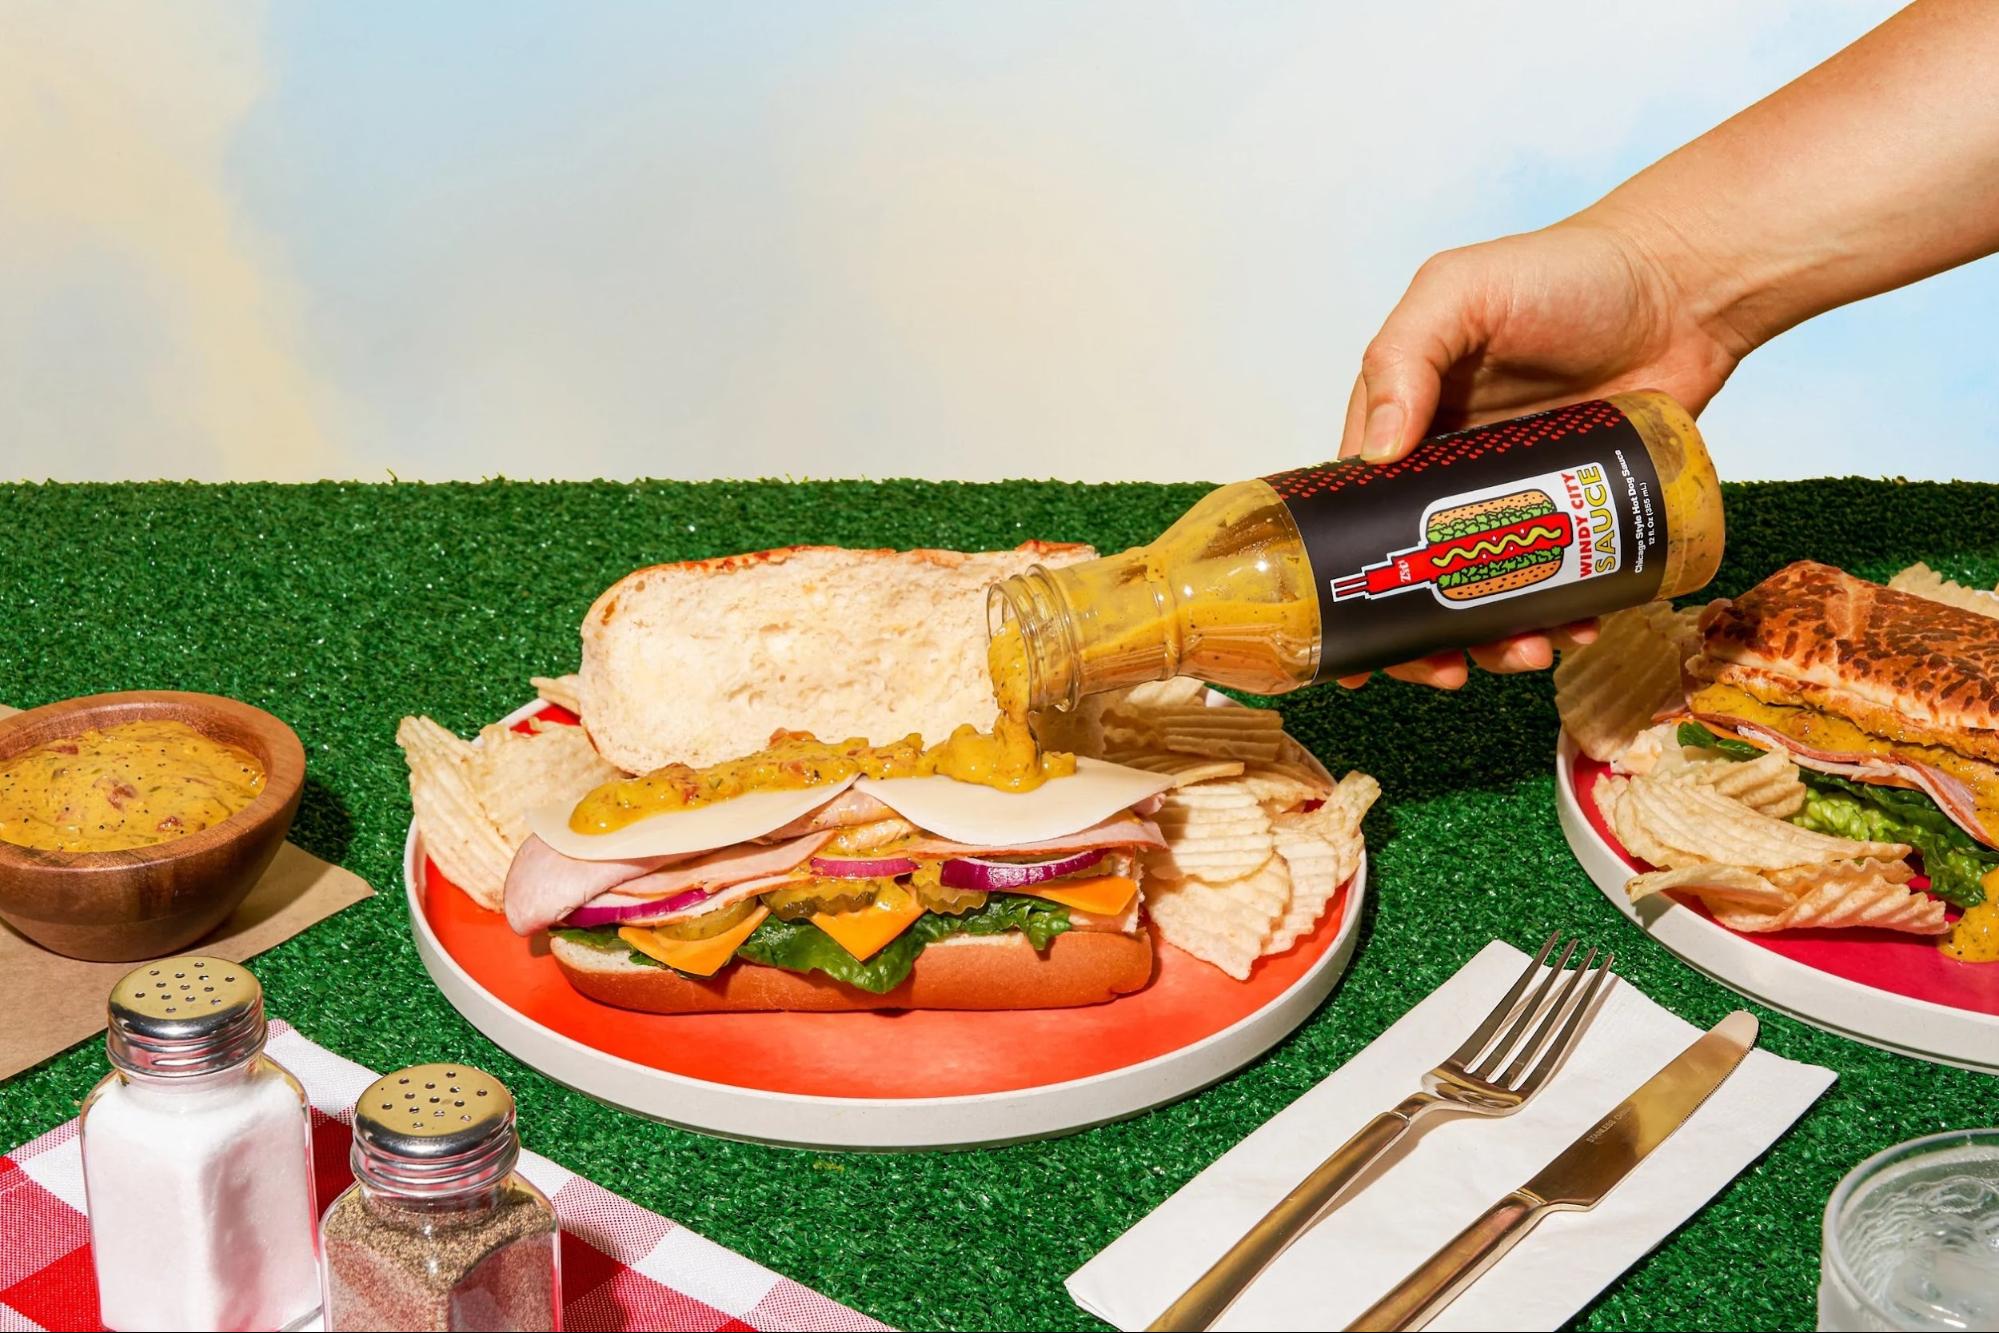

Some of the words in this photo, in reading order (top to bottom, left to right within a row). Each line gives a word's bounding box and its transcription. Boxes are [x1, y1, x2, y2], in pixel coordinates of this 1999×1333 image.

[1614, 449, 1630, 477] Sauce
[1561, 472, 1584, 510] CITY
[1625, 476, 1637, 496] Dog
[1630, 496, 1642, 515] Hot
[1643, 498, 1654, 517] (355
[1576, 465, 1616, 574] SAUCE
[1634, 514, 1645, 540] Style
[1647, 516, 1655, 528] Oz
[1575, 514, 1593, 578] WINDY
[1648, 536, 1655, 545] 12
[1634, 541, 1646, 574] Chicago
